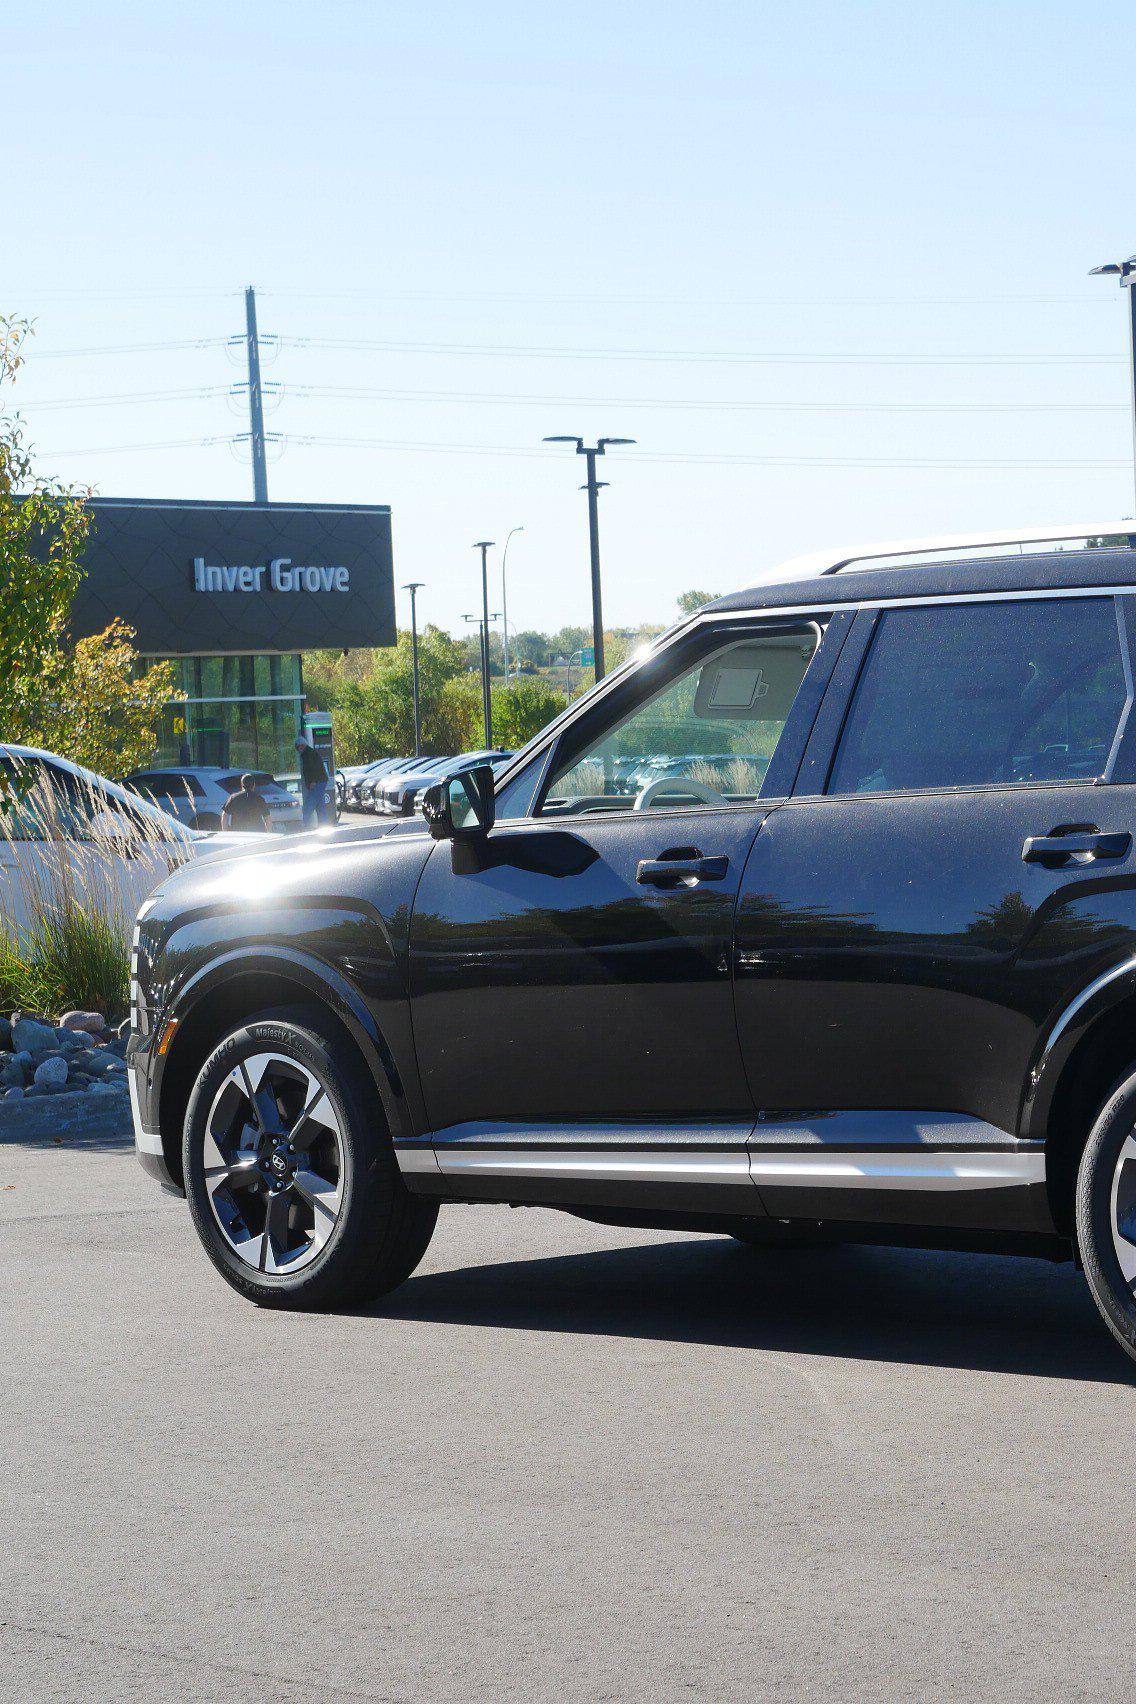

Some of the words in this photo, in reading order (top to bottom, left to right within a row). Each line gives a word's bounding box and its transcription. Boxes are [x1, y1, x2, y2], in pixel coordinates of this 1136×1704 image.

[194, 557, 266, 592] Inver
[270, 558, 350, 592] Grove
[255, 1027, 287, 1039] Majesty
